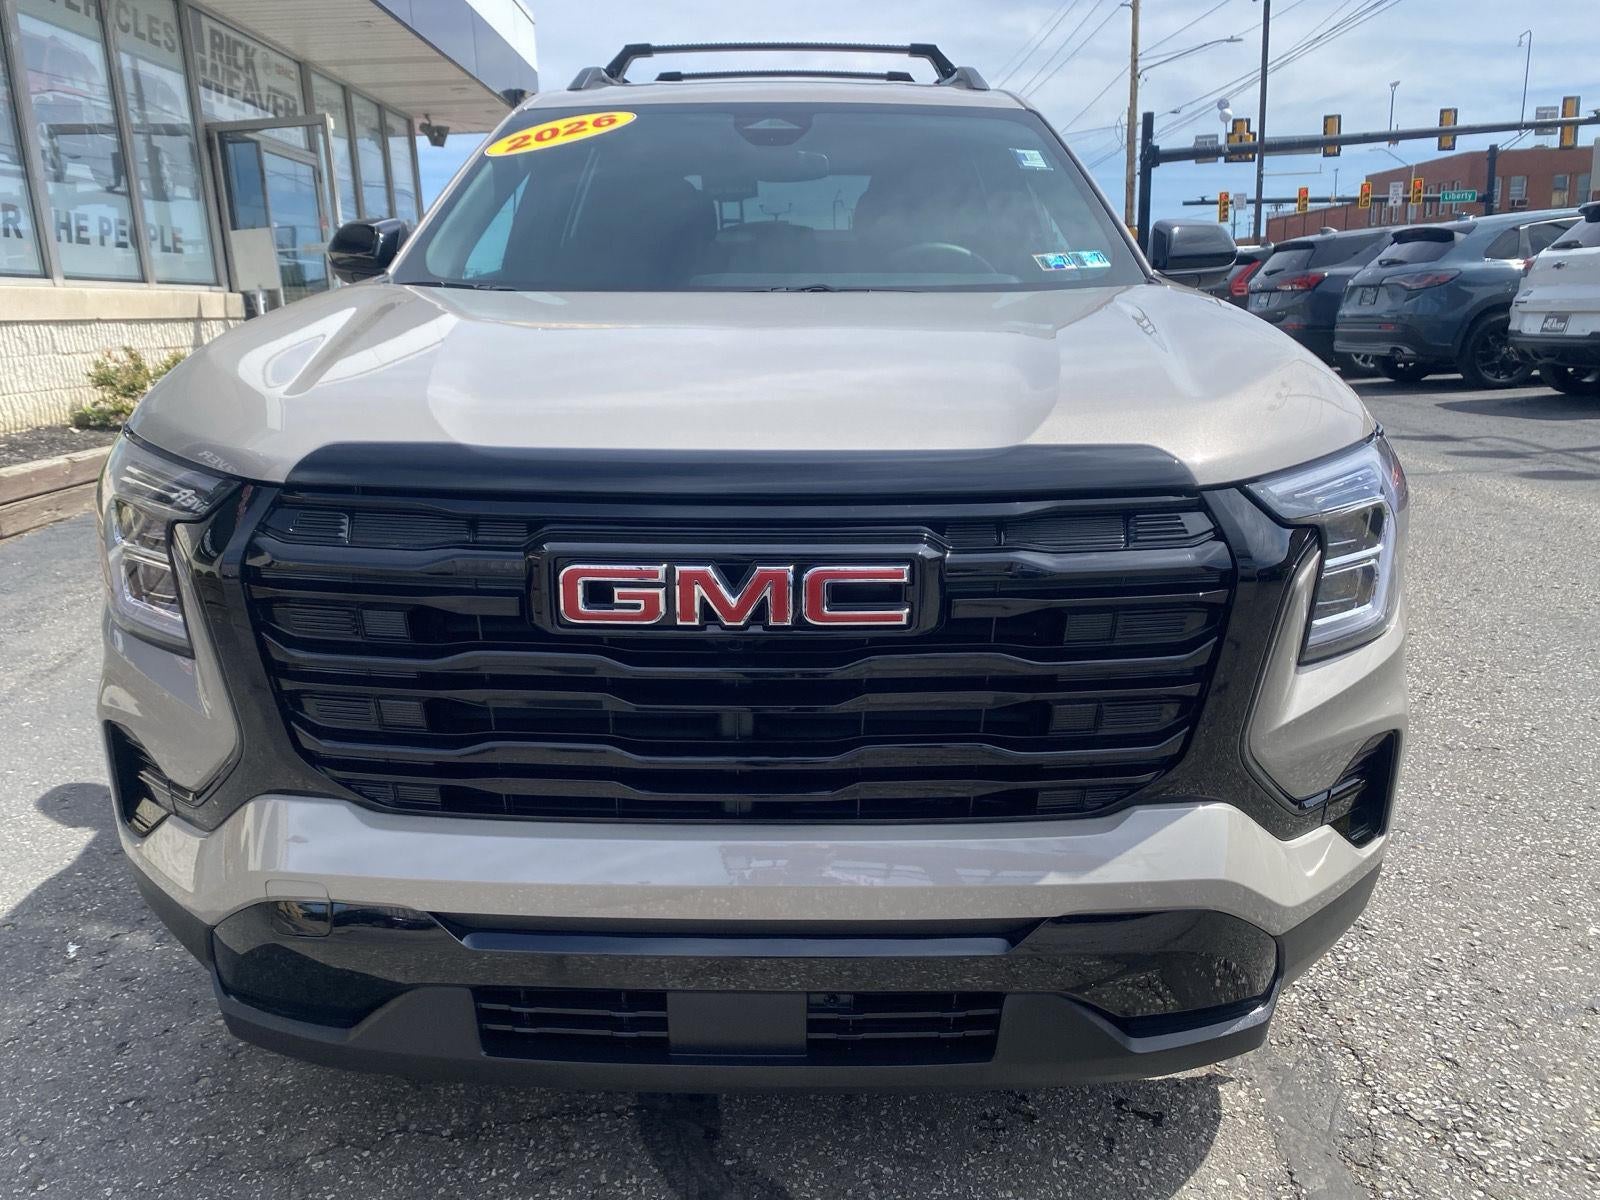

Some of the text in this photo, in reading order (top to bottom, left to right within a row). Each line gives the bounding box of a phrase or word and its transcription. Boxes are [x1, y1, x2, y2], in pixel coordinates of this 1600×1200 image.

[208, 28, 258, 78] RICK
[506, 115, 618, 152] 2026
[1445, 191, 1473, 201] Liberty
[558, 564, 910, 626] GMC
